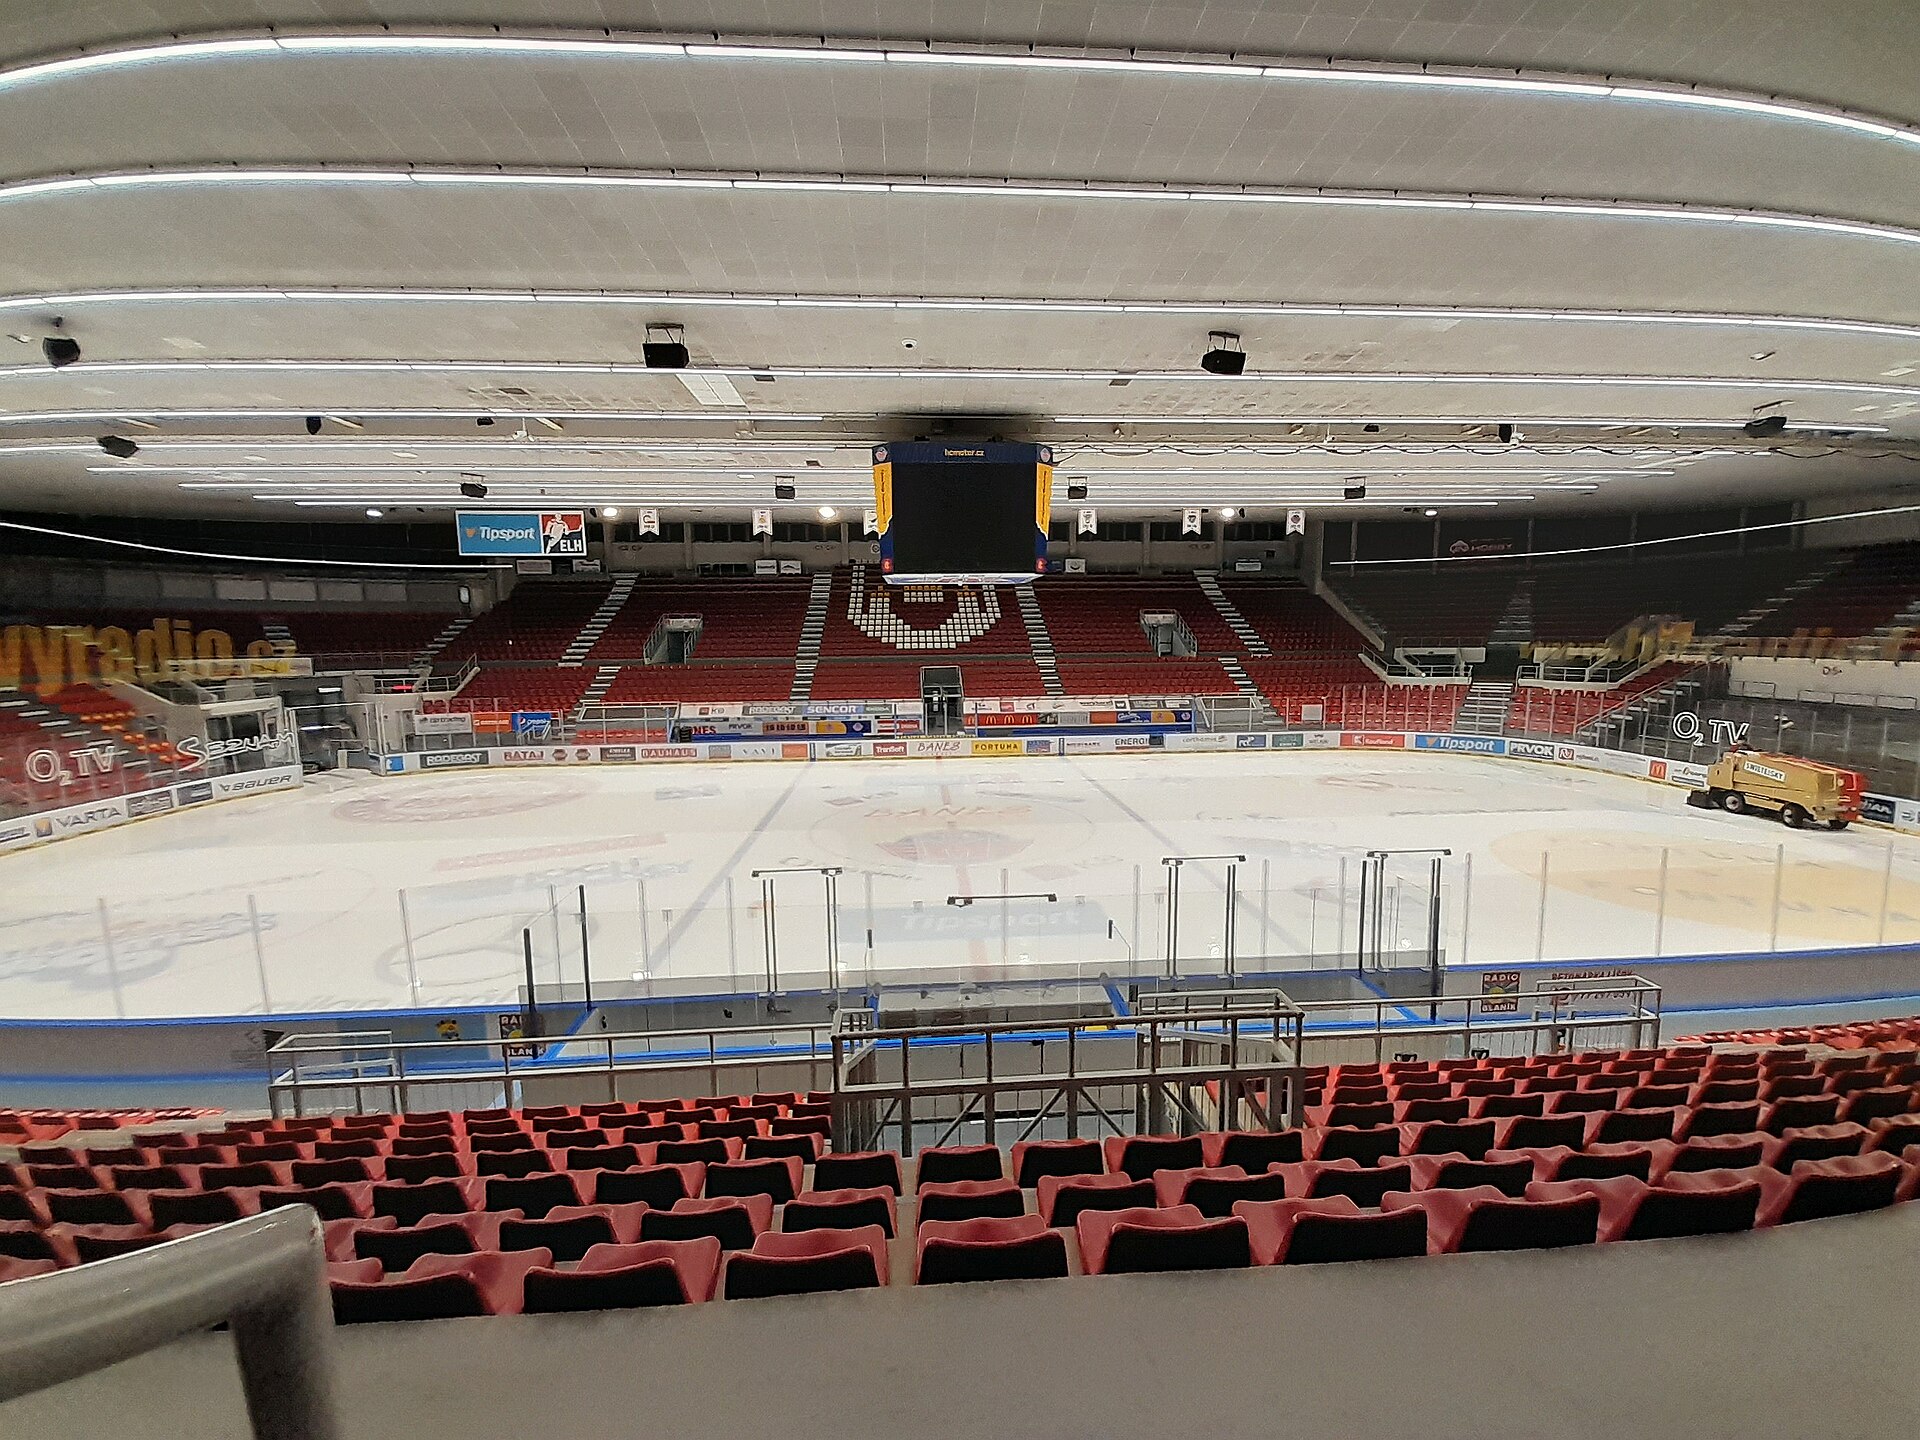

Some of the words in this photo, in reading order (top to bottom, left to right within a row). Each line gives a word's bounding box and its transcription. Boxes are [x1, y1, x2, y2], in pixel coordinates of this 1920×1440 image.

[479, 526, 536, 541] Tipsport
[559, 539, 583, 552] ELH
[807, 704, 858, 714] SENCOR
[1709, 719, 1749, 745] TV
[918, 741, 961, 751] BANES
[974, 743, 1018, 751] FORTUNA
[1439, 736, 1496, 752] Tipsport
[1510, 741, 1554, 757] PRVOK
[641, 748, 698, 758] BAUHAUS
[70, 745, 117, 778] TV
[56, 807, 122, 828] VARTA
[1484, 973, 1519, 983] RADIO
[506, 1046, 544, 1056] LANK
